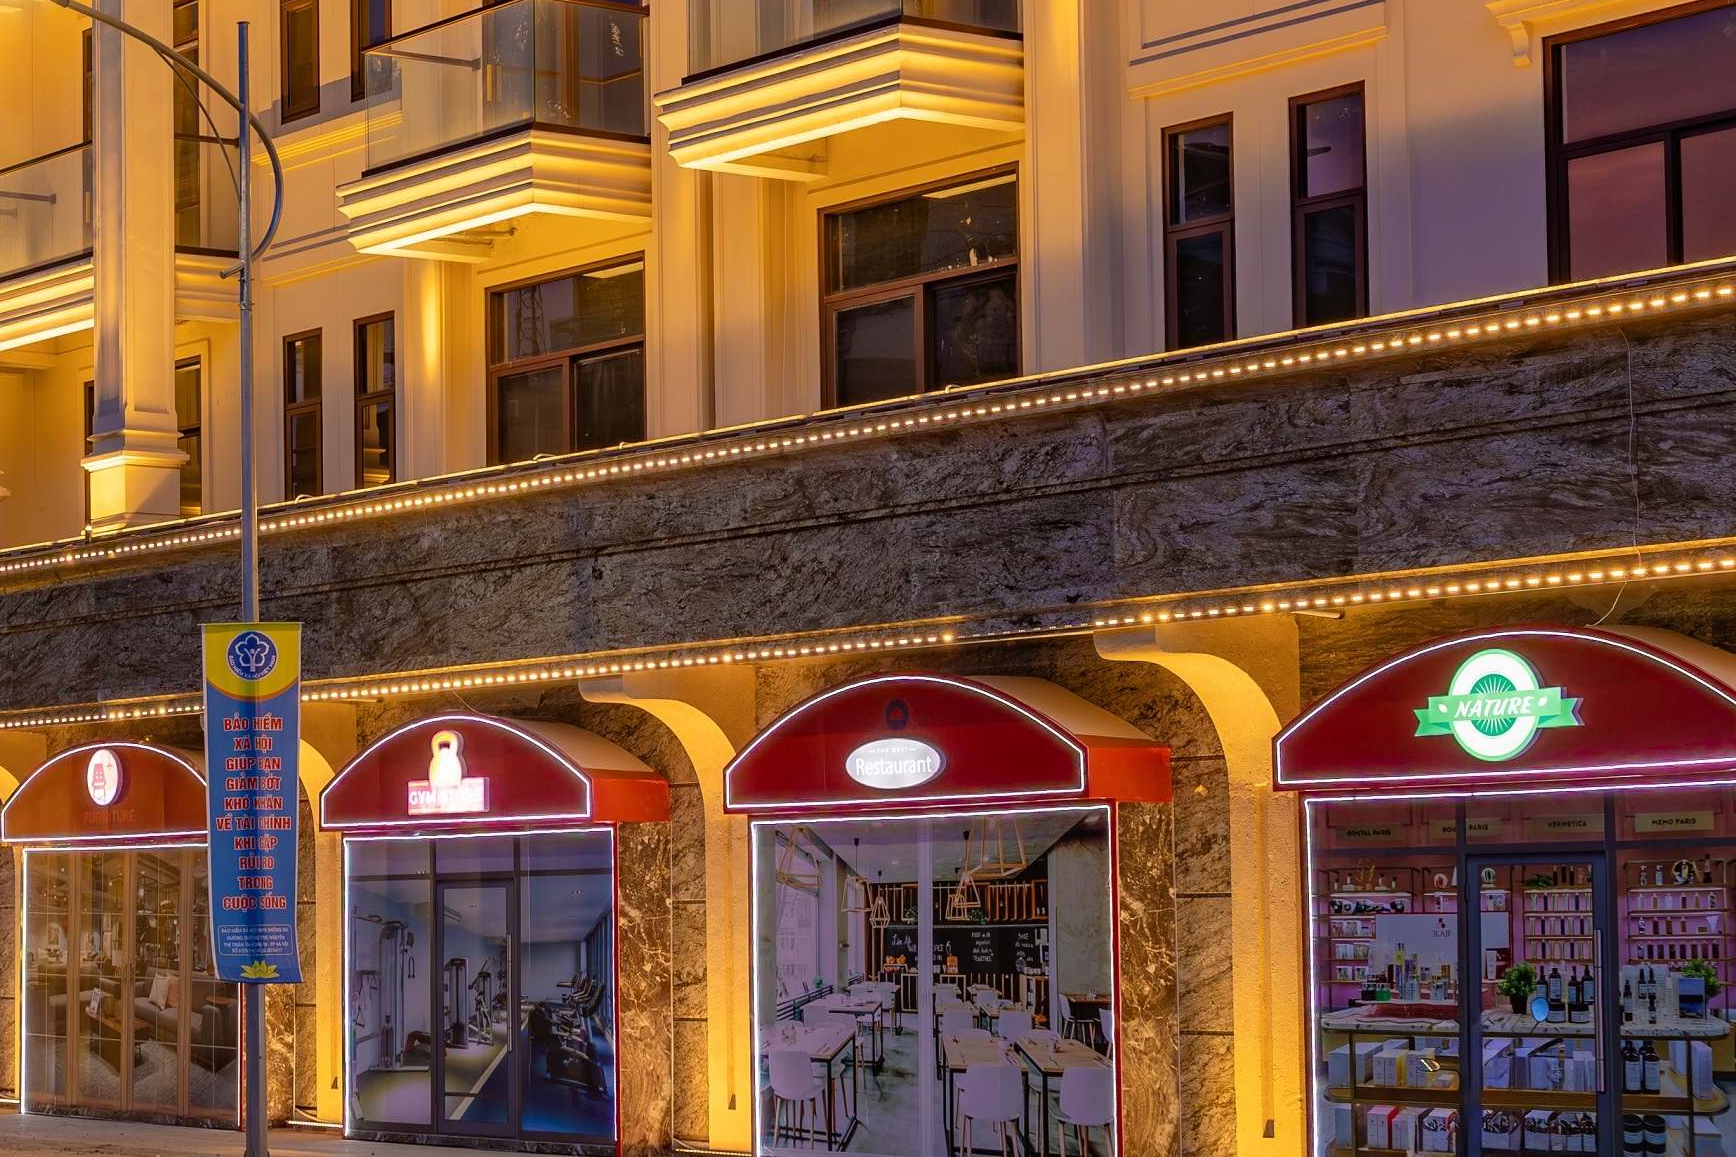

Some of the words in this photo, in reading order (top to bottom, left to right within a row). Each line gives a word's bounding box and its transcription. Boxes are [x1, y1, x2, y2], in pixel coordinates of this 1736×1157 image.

[1454, 695, 1535, 718] NATURE
[224, 712, 250, 732] BẢO
[253, 712, 283, 731] HIỂM
[234, 735, 252, 751] XÃ
[254, 734, 273, 753] HỘI
[225, 753, 255, 771] GIÚP
[258, 756, 281, 774] BẠN
[855, 756, 932, 776] Restaurant
[225, 772, 258, 791] GIẢM
[261, 773, 282, 791] BỚT
[224, 794, 250, 811] KHÓ
[409, 790, 436, 806] GYM
[235, 814, 255, 830] TÀI
[258, 813, 292, 831] CHÍNH
[1547, 820, 1587, 828] HERMETICA
[1651, 818, 1673, 826] MEMO
[1676, 817, 1696, 825] PARIS
[234, 836, 255, 851] KHI
[259, 834, 278, 853] GẶP
[239, 851, 260, 870] RỦI
[262, 856, 274, 870] RO
[237, 876, 273, 890] TRONG
[223, 894, 257, 912] CUỘC
[260, 892, 287, 910] SỐNG
